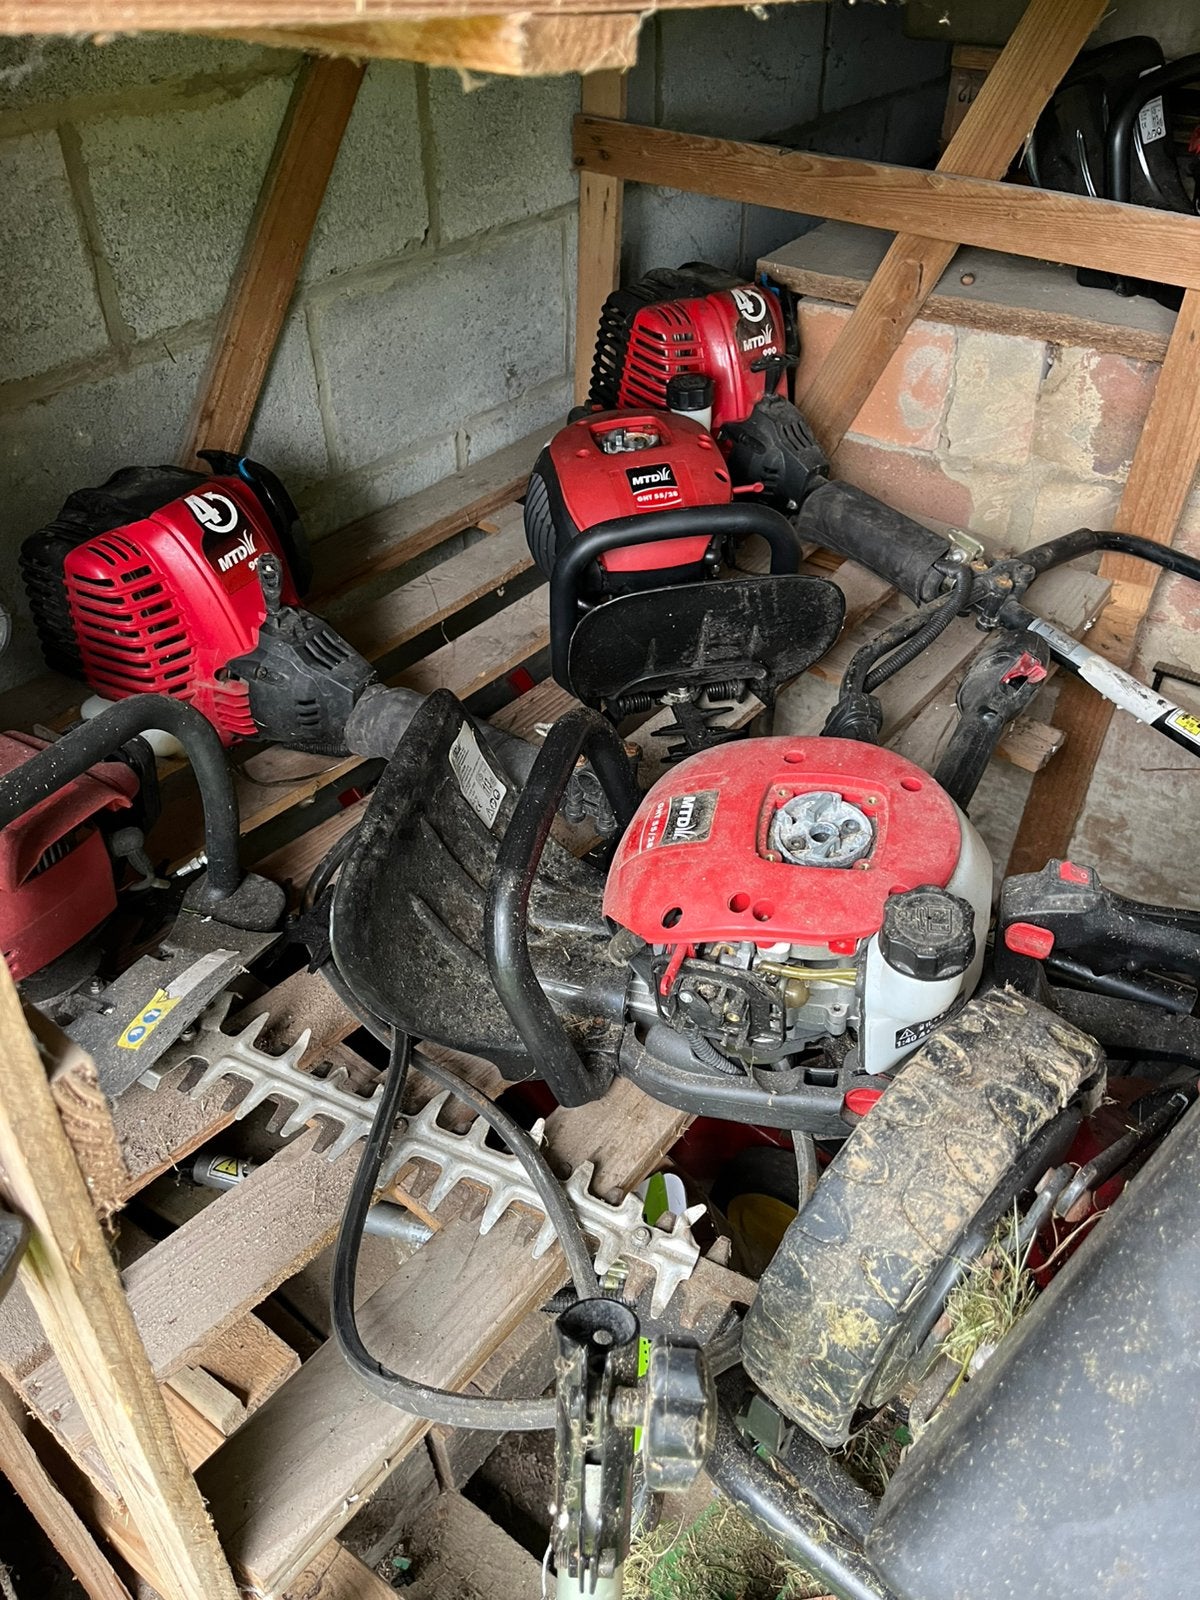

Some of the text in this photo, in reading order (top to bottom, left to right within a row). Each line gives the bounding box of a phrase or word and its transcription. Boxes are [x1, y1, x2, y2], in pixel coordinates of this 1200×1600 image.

[742, 334, 766, 352] MTD
[631, 473, 661, 487] MTD
[217, 545, 249, 573] MTD
[676, 795, 697, 829] MTD
